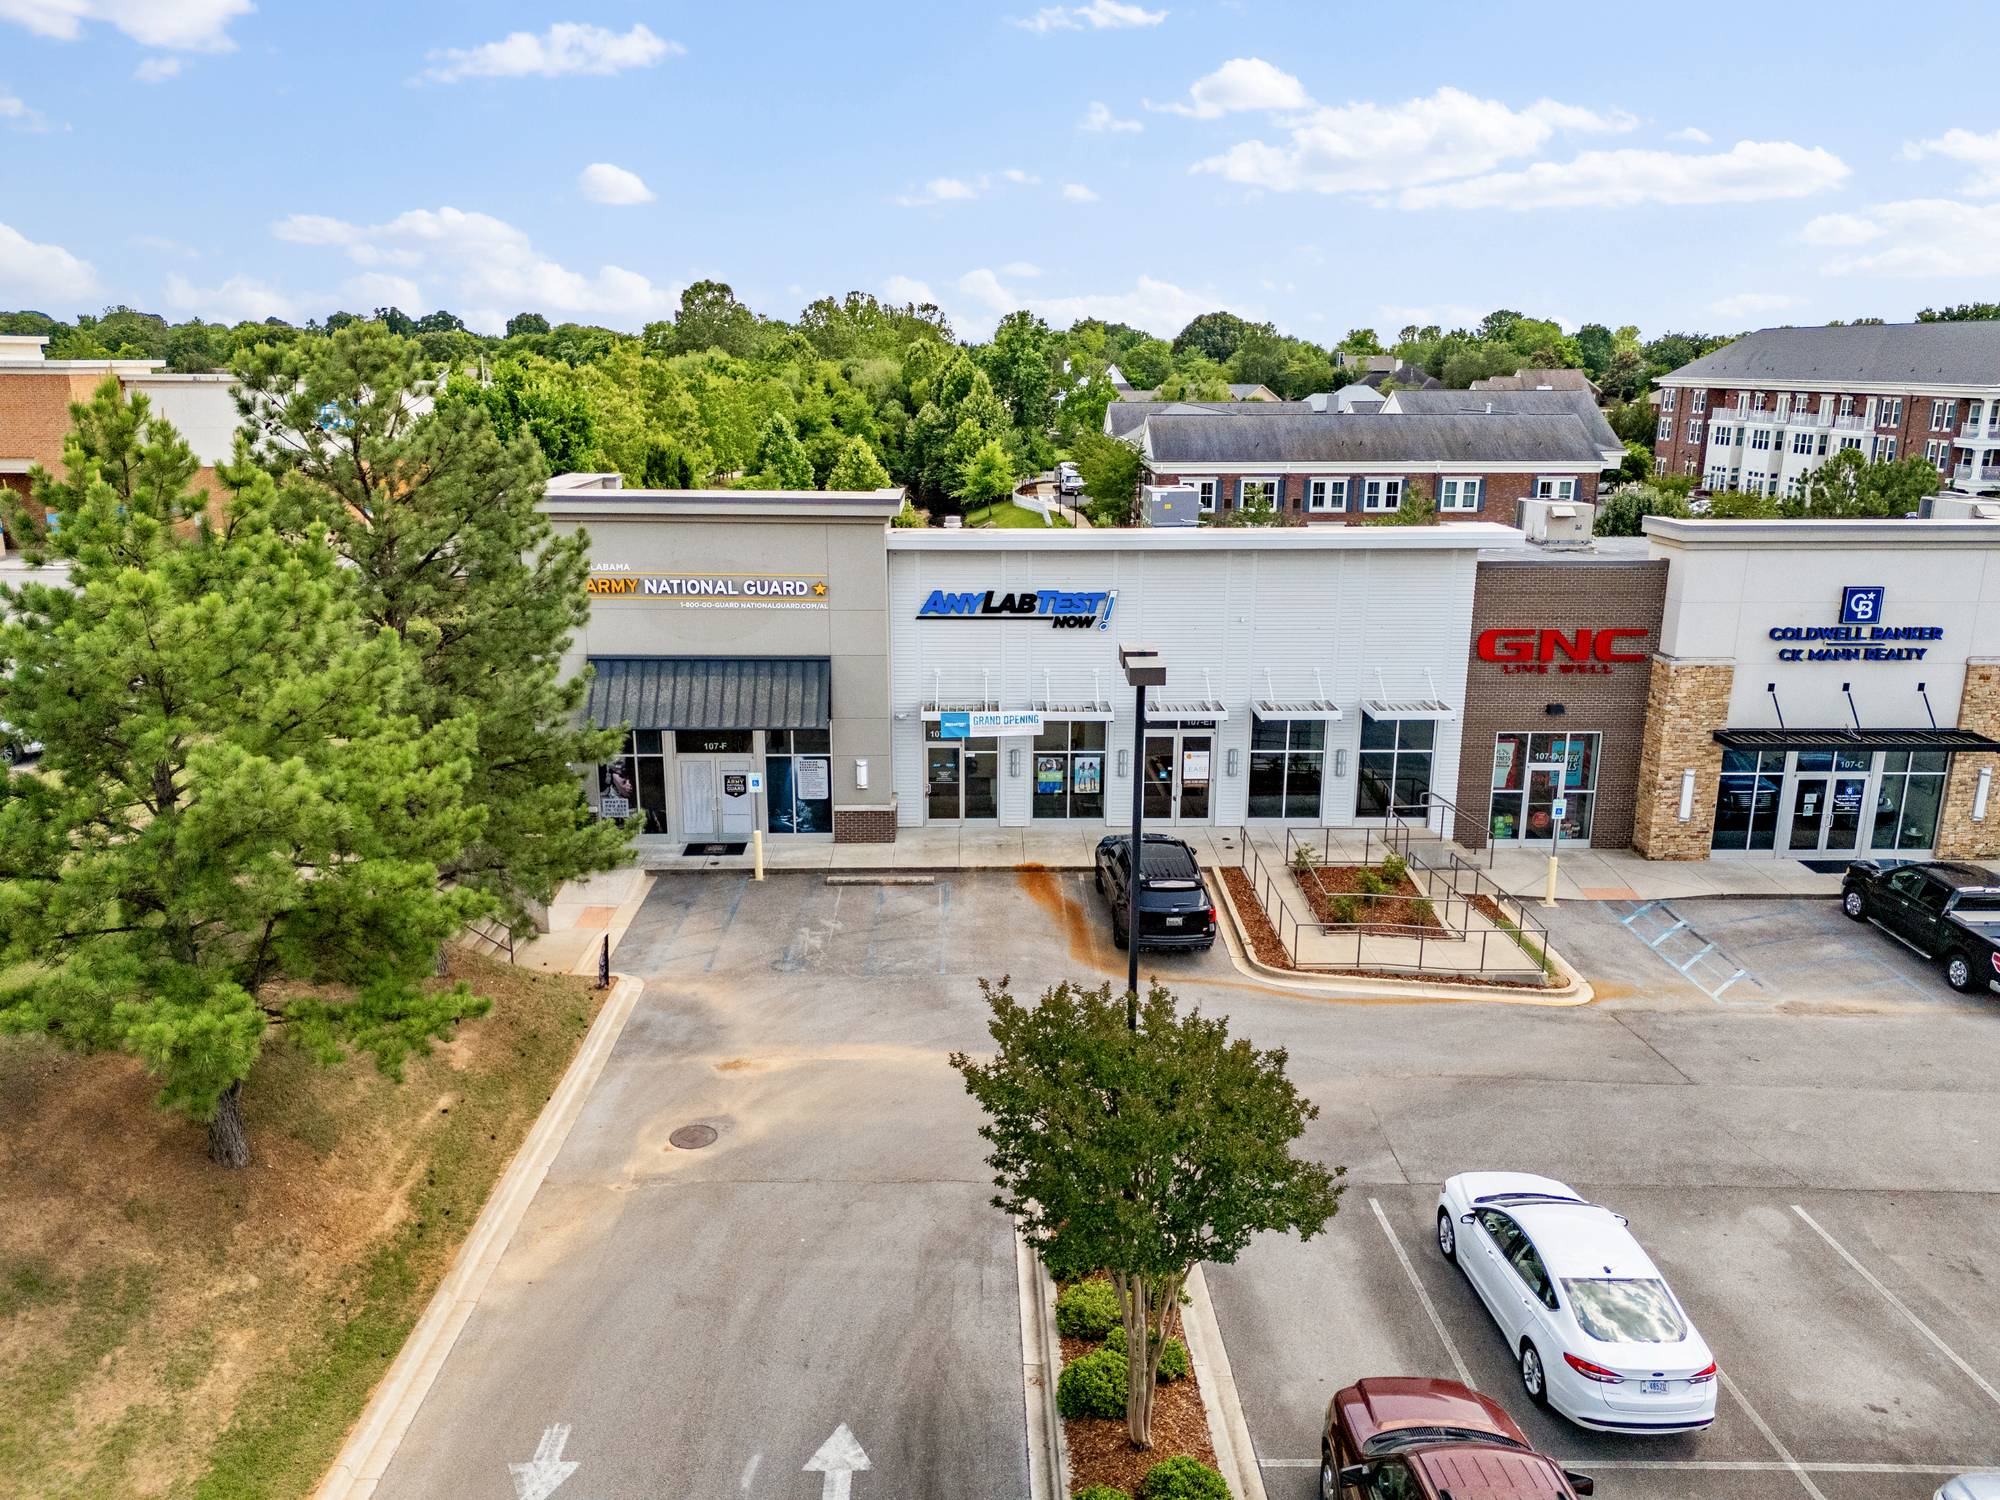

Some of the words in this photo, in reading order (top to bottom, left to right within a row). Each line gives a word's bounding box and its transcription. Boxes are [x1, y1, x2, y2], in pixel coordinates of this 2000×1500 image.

[586, 579, 639, 593] ARMY
[644, 579, 738, 596] NATIONAL
[743, 580, 808, 596] GUARD
[1053, 616, 1096, 629] NOW
[1769, 627, 1867, 641] COLDWELL
[1870, 627, 1944, 641] BANKER
[1477, 629, 1648, 662] GNC
[1778, 648, 1804, 661] CK
[1807, 648, 1860, 661] MANN
[1863, 648, 1928, 660] REALTY
[1503, 664, 1548, 675] LIVE
[1559, 664, 1613, 675] WELL
[973, 715, 1001, 725] GRAND
[1003, 714, 1039, 725] OPENING
[704, 742, 727, 750] 107-F
